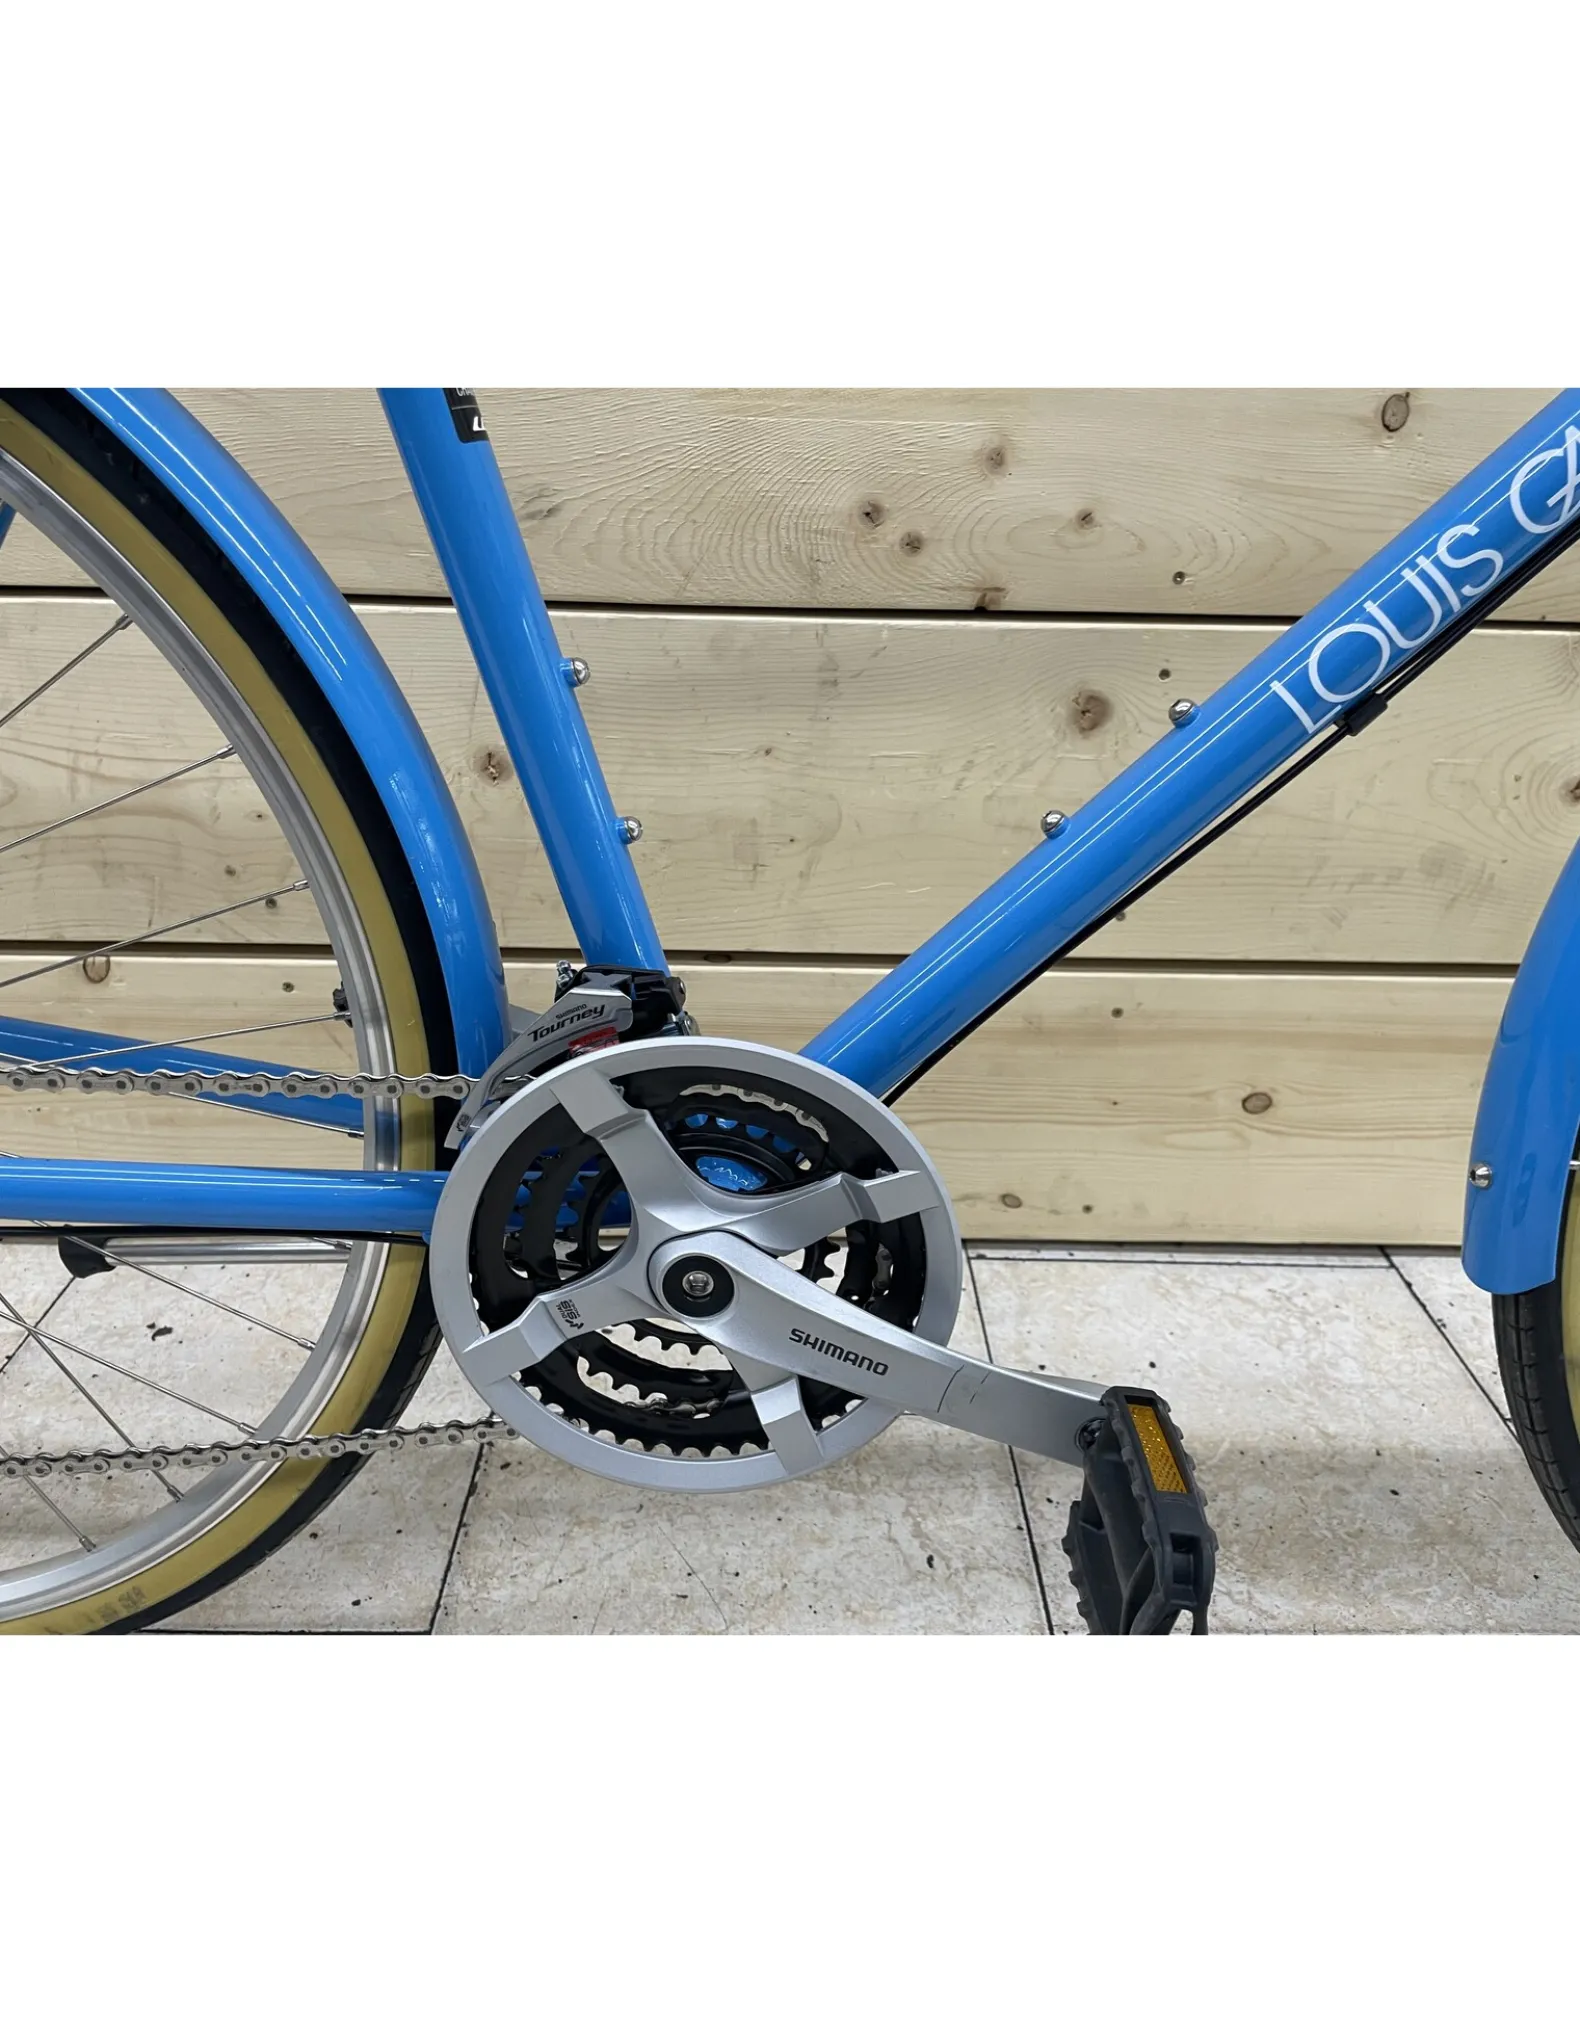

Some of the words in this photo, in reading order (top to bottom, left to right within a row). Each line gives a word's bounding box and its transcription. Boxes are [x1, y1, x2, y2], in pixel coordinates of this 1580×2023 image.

[1269, 523, 1504, 735] LOUIS
[527, 1004, 605, 1042] Tourney
[556, 1003, 587, 1020] SHIMANO
[560, 1300, 578, 1320] SIS
[788, 1327, 889, 1376] SHIMANO
